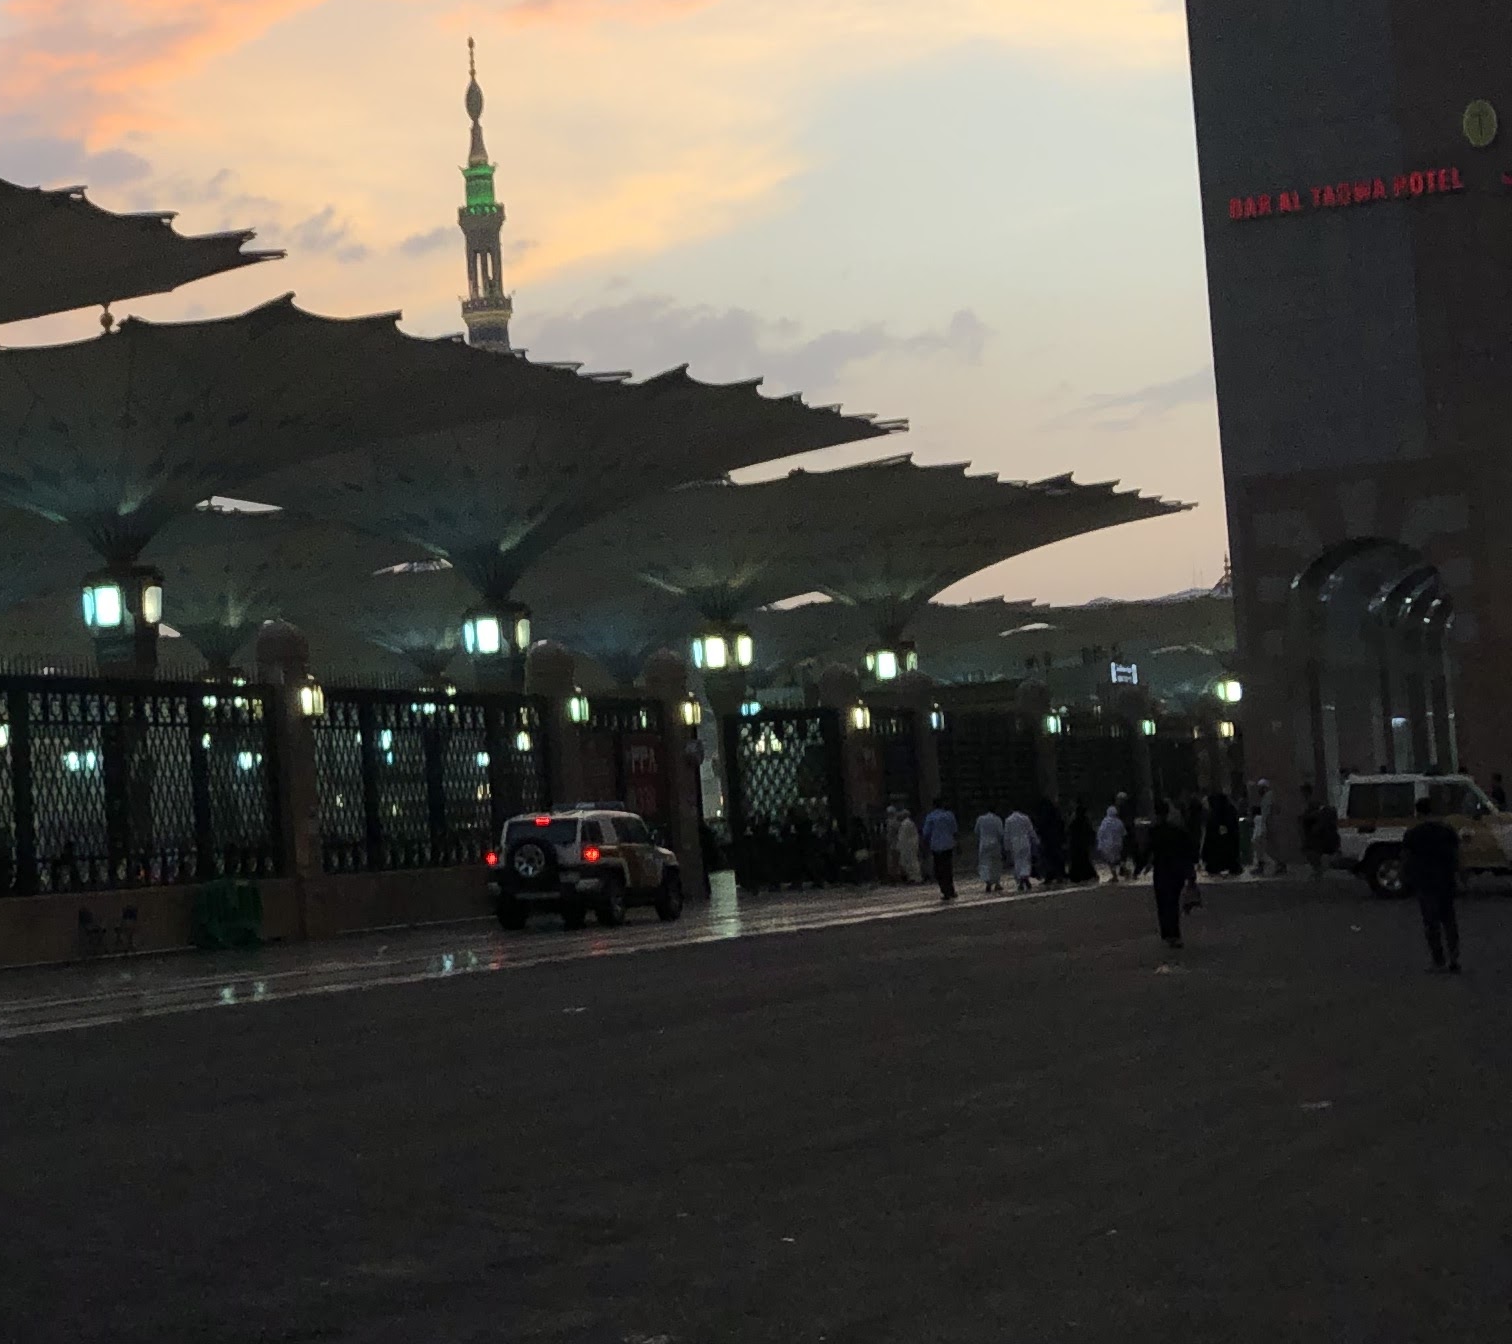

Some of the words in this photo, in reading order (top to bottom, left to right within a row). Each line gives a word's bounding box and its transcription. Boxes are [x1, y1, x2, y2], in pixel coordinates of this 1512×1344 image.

[1229, 193, 1270, 219] DAR
[1278, 191, 1301, 212] AL
[1310, 177, 1386, 206] TAQWA
[1393, 168, 1464, 196] HOTEL
